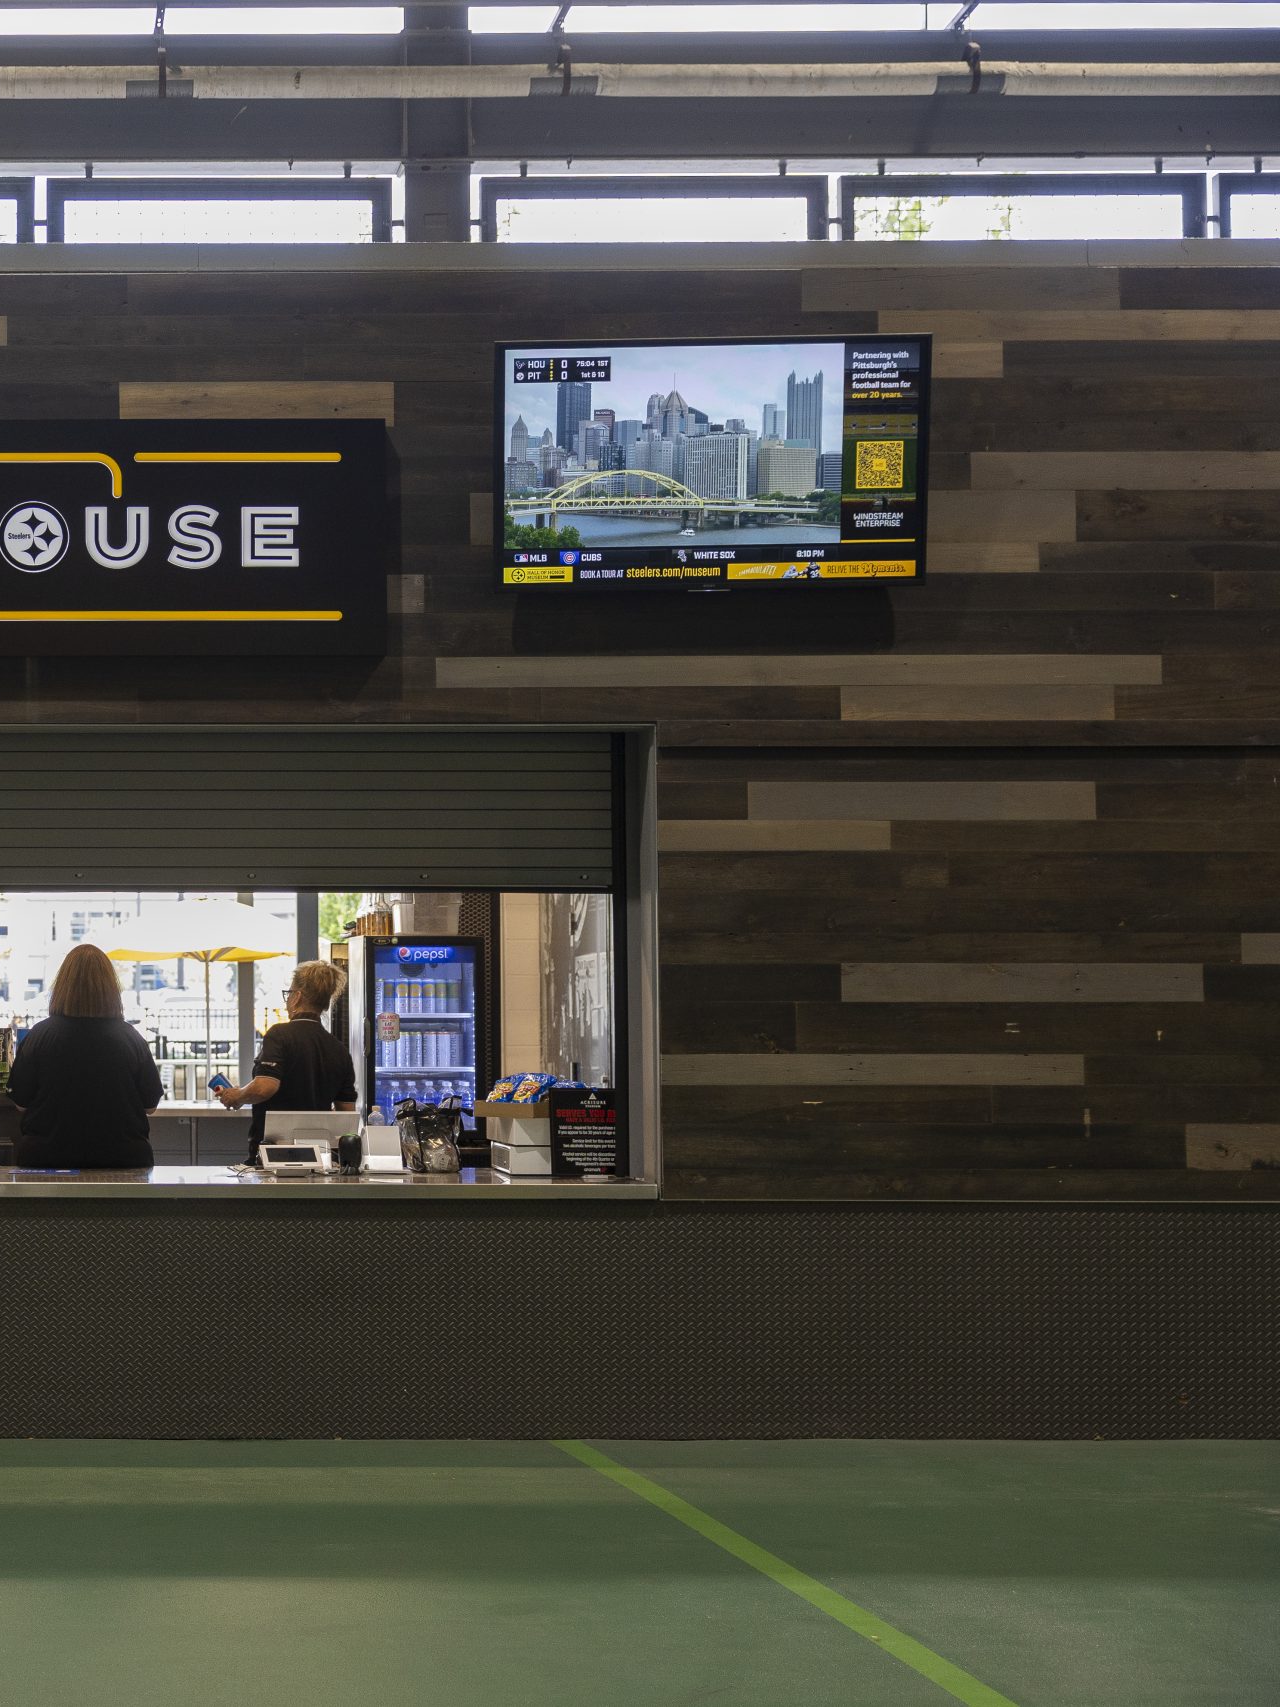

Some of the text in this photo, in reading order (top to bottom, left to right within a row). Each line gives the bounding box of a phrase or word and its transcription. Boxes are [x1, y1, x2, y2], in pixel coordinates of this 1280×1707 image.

[853, 350, 909, 359] Partnering with
[561, 360, 567, 368] 0
[852, 361, 897, 370] Pittsburgh's
[561, 371, 567, 379] 0
[852, 371, 899, 380] professional
[852, 381, 880, 389] football
[900, 380, 911, 388] for
[881, 391, 903, 399] years.
[853, 512, 903, 520] WINDSTREAM
[855, 519, 901, 528] ENTERPRISE
[529, 549, 824, 562] MLB CUBS WHITE SOX 8:10 PM
[626, 565, 721, 579] steelers.com/museum
[827, 566, 848, 574] RELIVE
[849, 565, 860, 573] THE
[580, 570, 624, 579] BOOK A TOUR AT
[413, 949, 448, 961] pepsi
